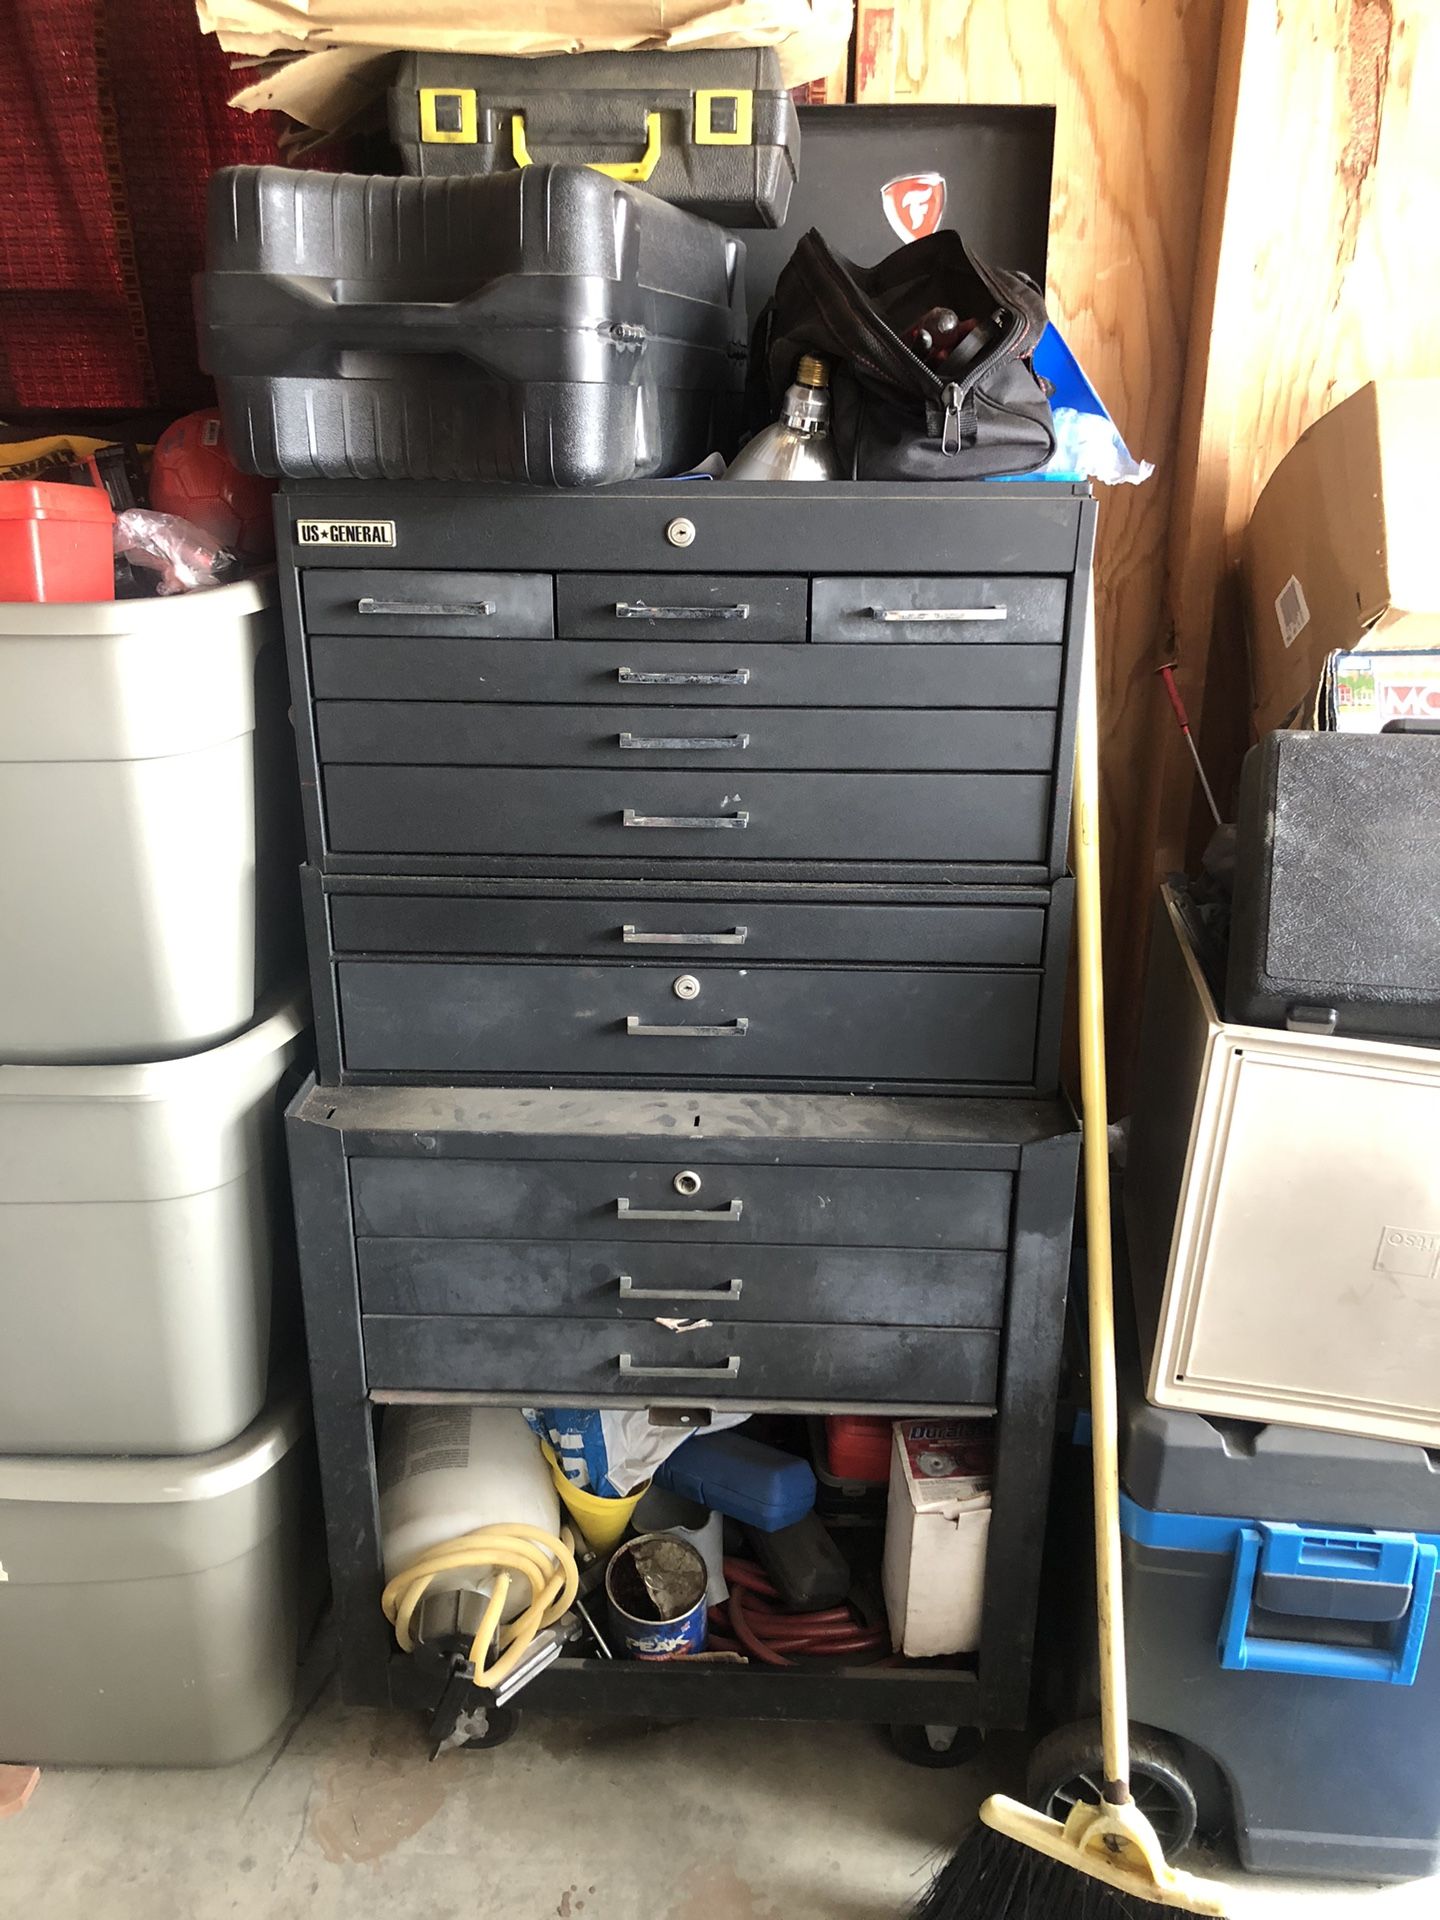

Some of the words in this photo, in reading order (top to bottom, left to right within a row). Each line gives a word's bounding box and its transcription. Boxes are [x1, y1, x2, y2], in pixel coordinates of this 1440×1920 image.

[301, 525, 320, 542] US
[330, 525, 389, 543] GENERAL
[625, 1633, 690, 1652] PEAK
